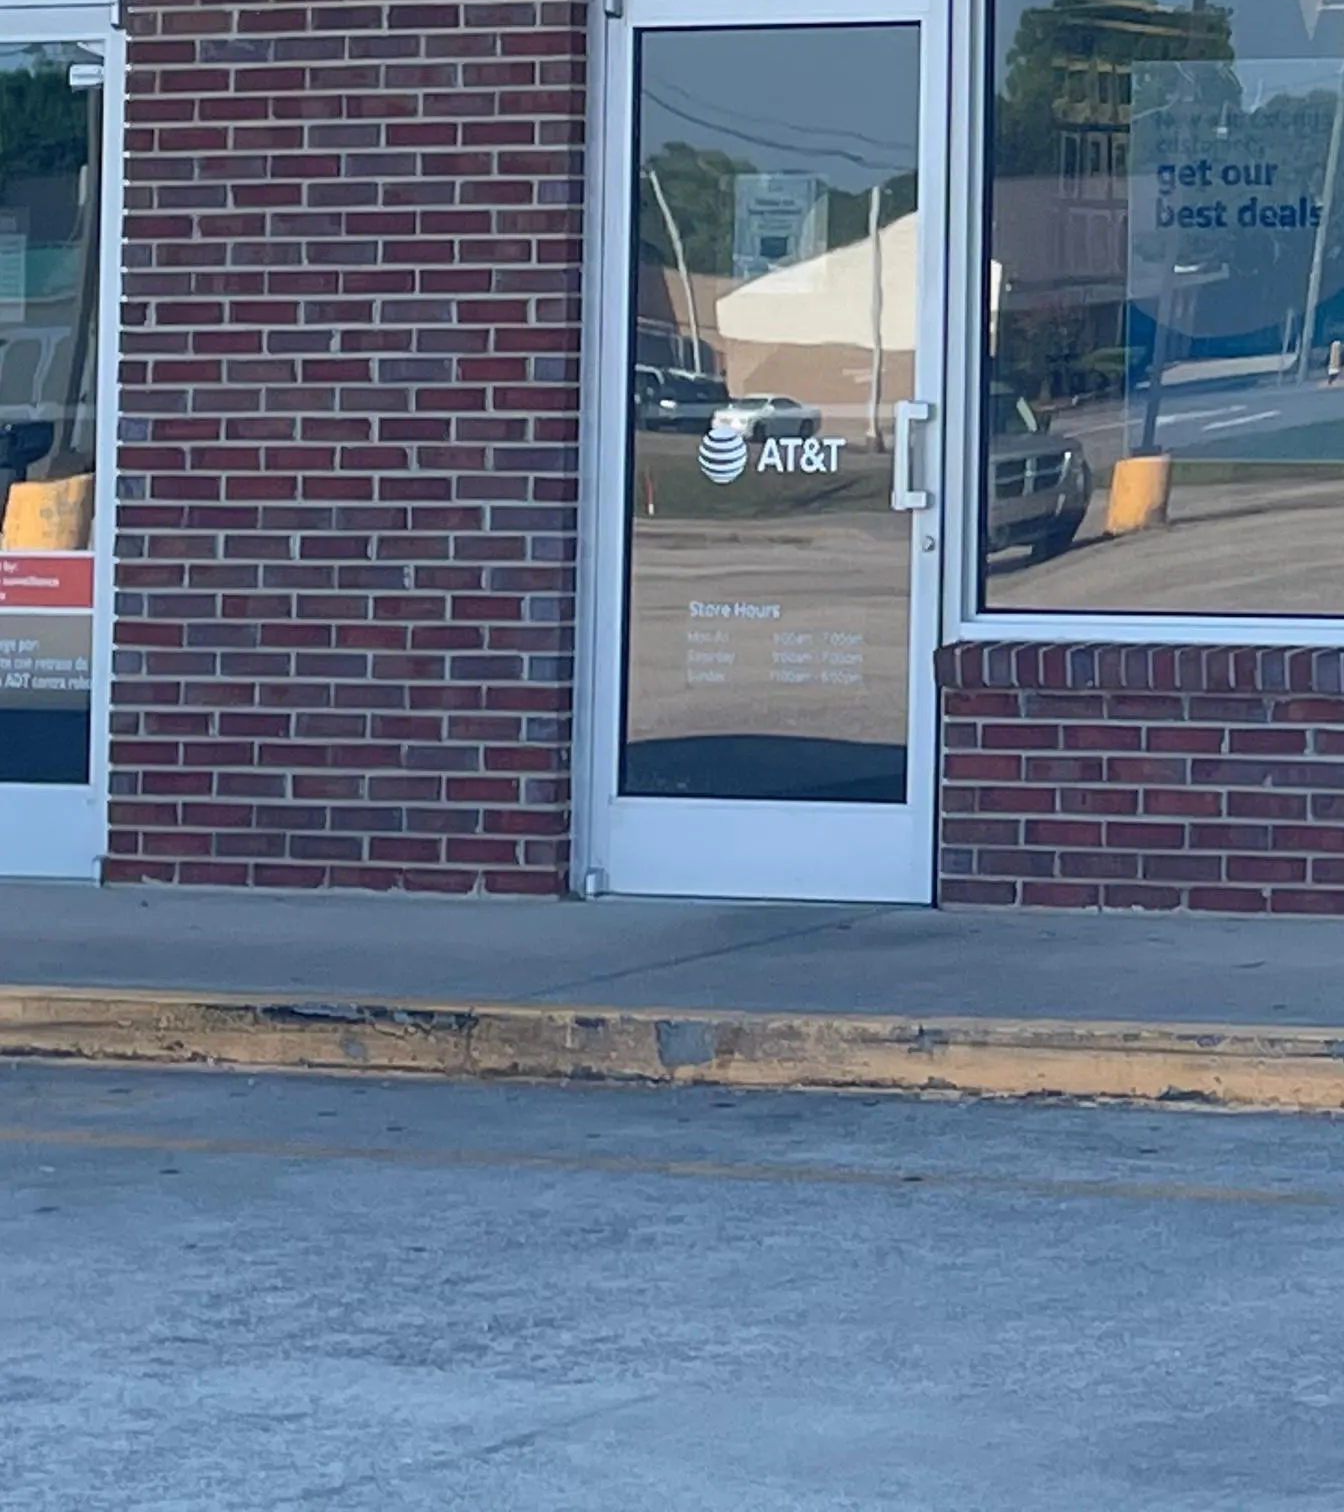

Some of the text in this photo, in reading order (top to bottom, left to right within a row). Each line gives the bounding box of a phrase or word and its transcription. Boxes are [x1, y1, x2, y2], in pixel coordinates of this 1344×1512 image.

[1157, 159, 1278, 195] get our
[1155, 196, 1324, 228] best deals
[757, 437, 847, 473] AT&T
[689, 600, 781, 619] Store Hours
